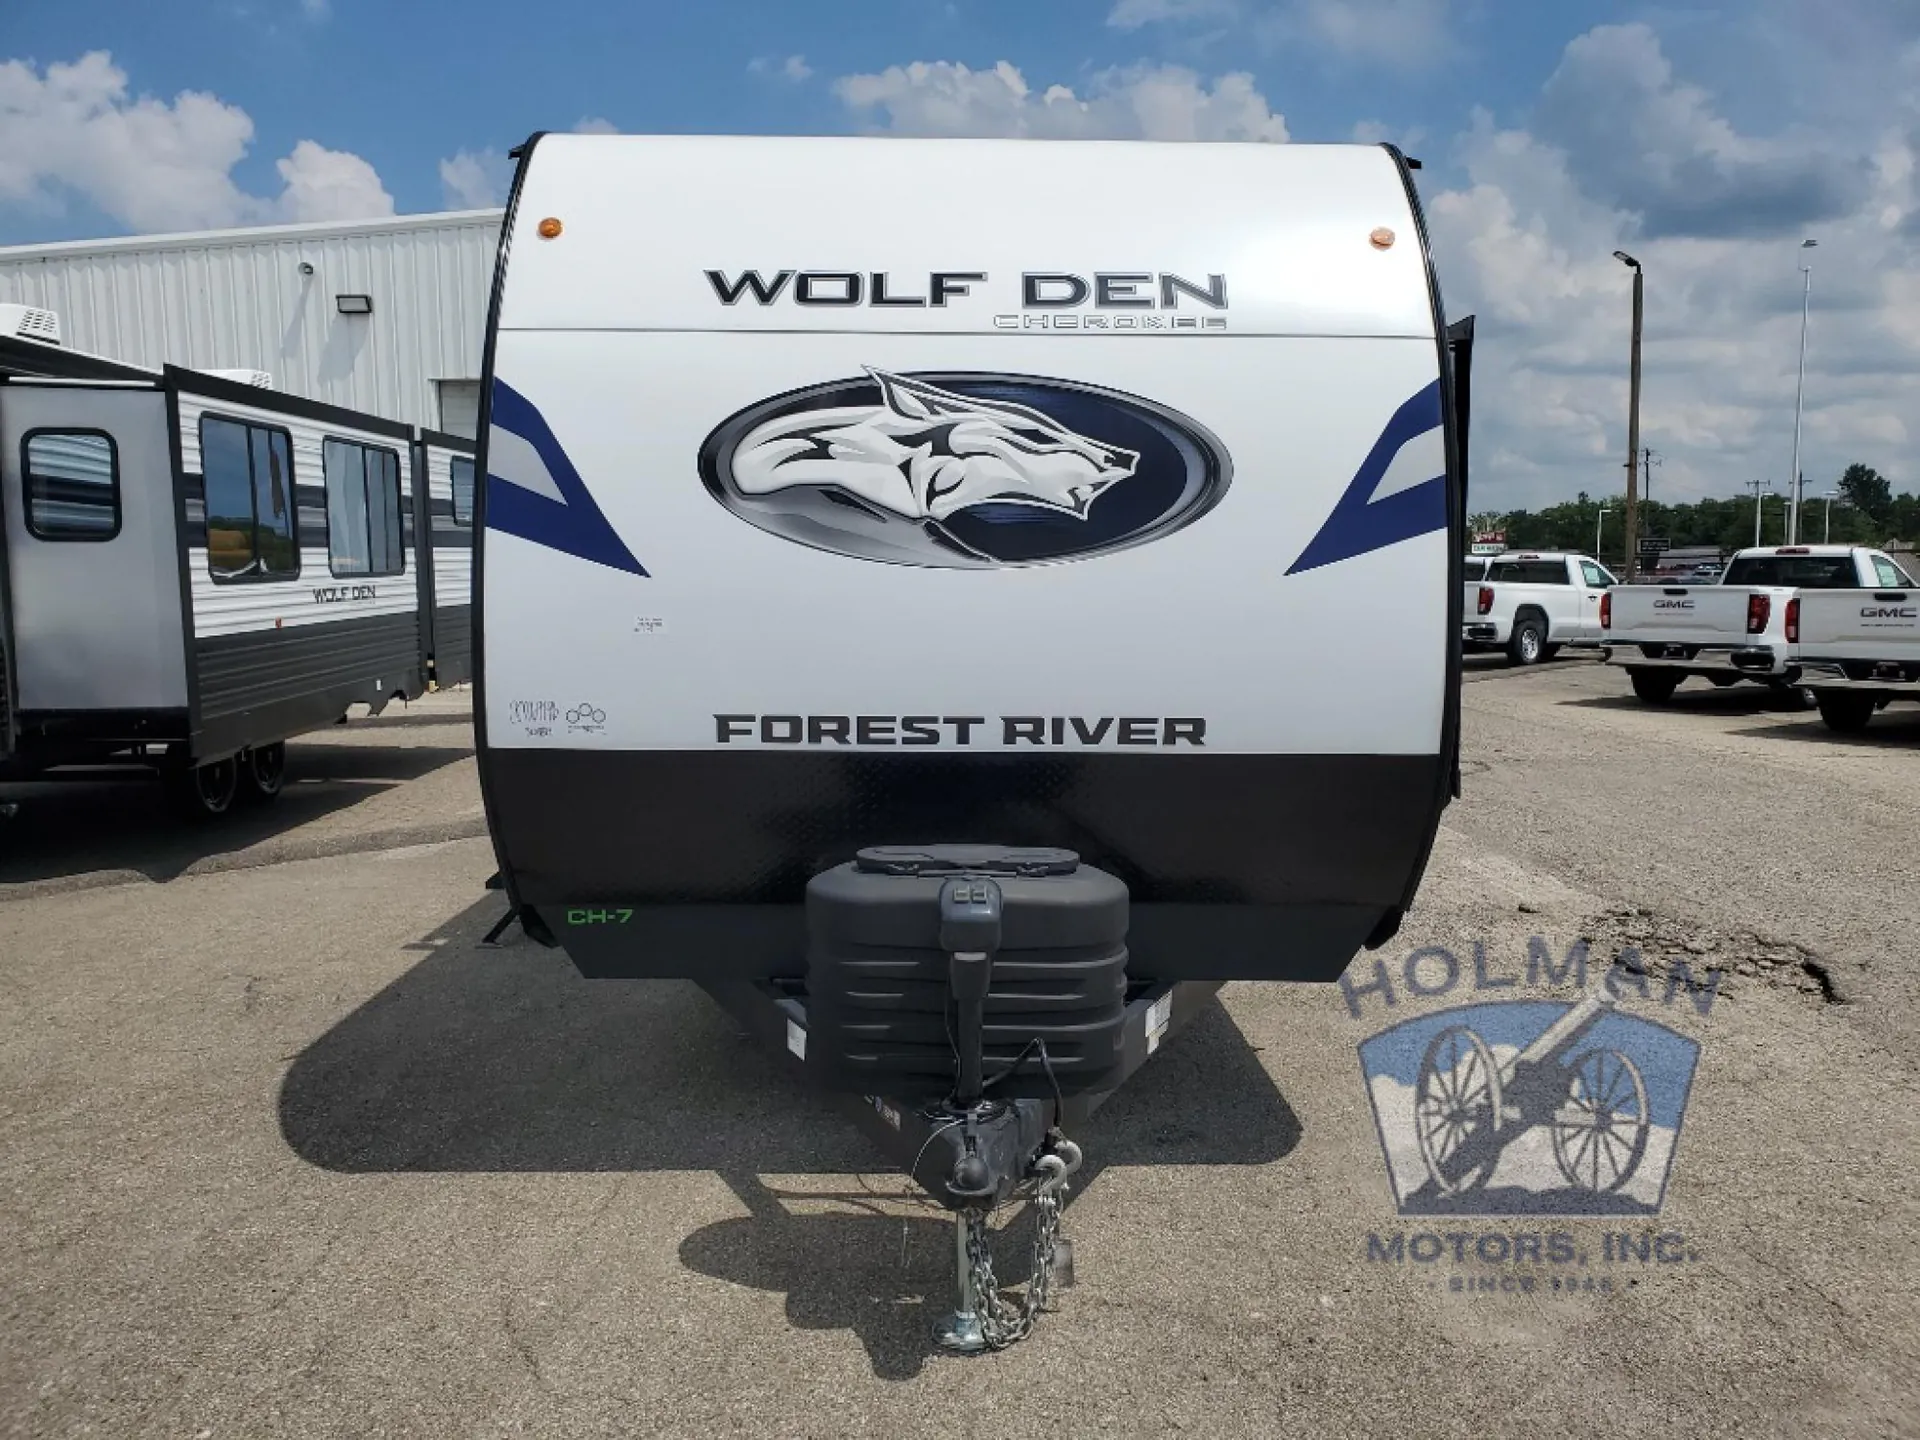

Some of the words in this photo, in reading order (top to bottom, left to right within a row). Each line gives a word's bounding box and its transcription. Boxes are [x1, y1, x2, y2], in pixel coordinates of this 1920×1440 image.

[703, 270, 989, 307] WOLF
[1021, 272, 1229, 309] DEN
[313, 587, 349, 604] WOLF
[352, 585, 376, 601] DEN
[1653, 599, 1696, 609] GMC
[1860, 607, 1917, 618] GMC
[713, 714, 985, 745] FOREST
[1000, 717, 1207, 746] RIVER
[566, 908, 634, 924] CH-7
